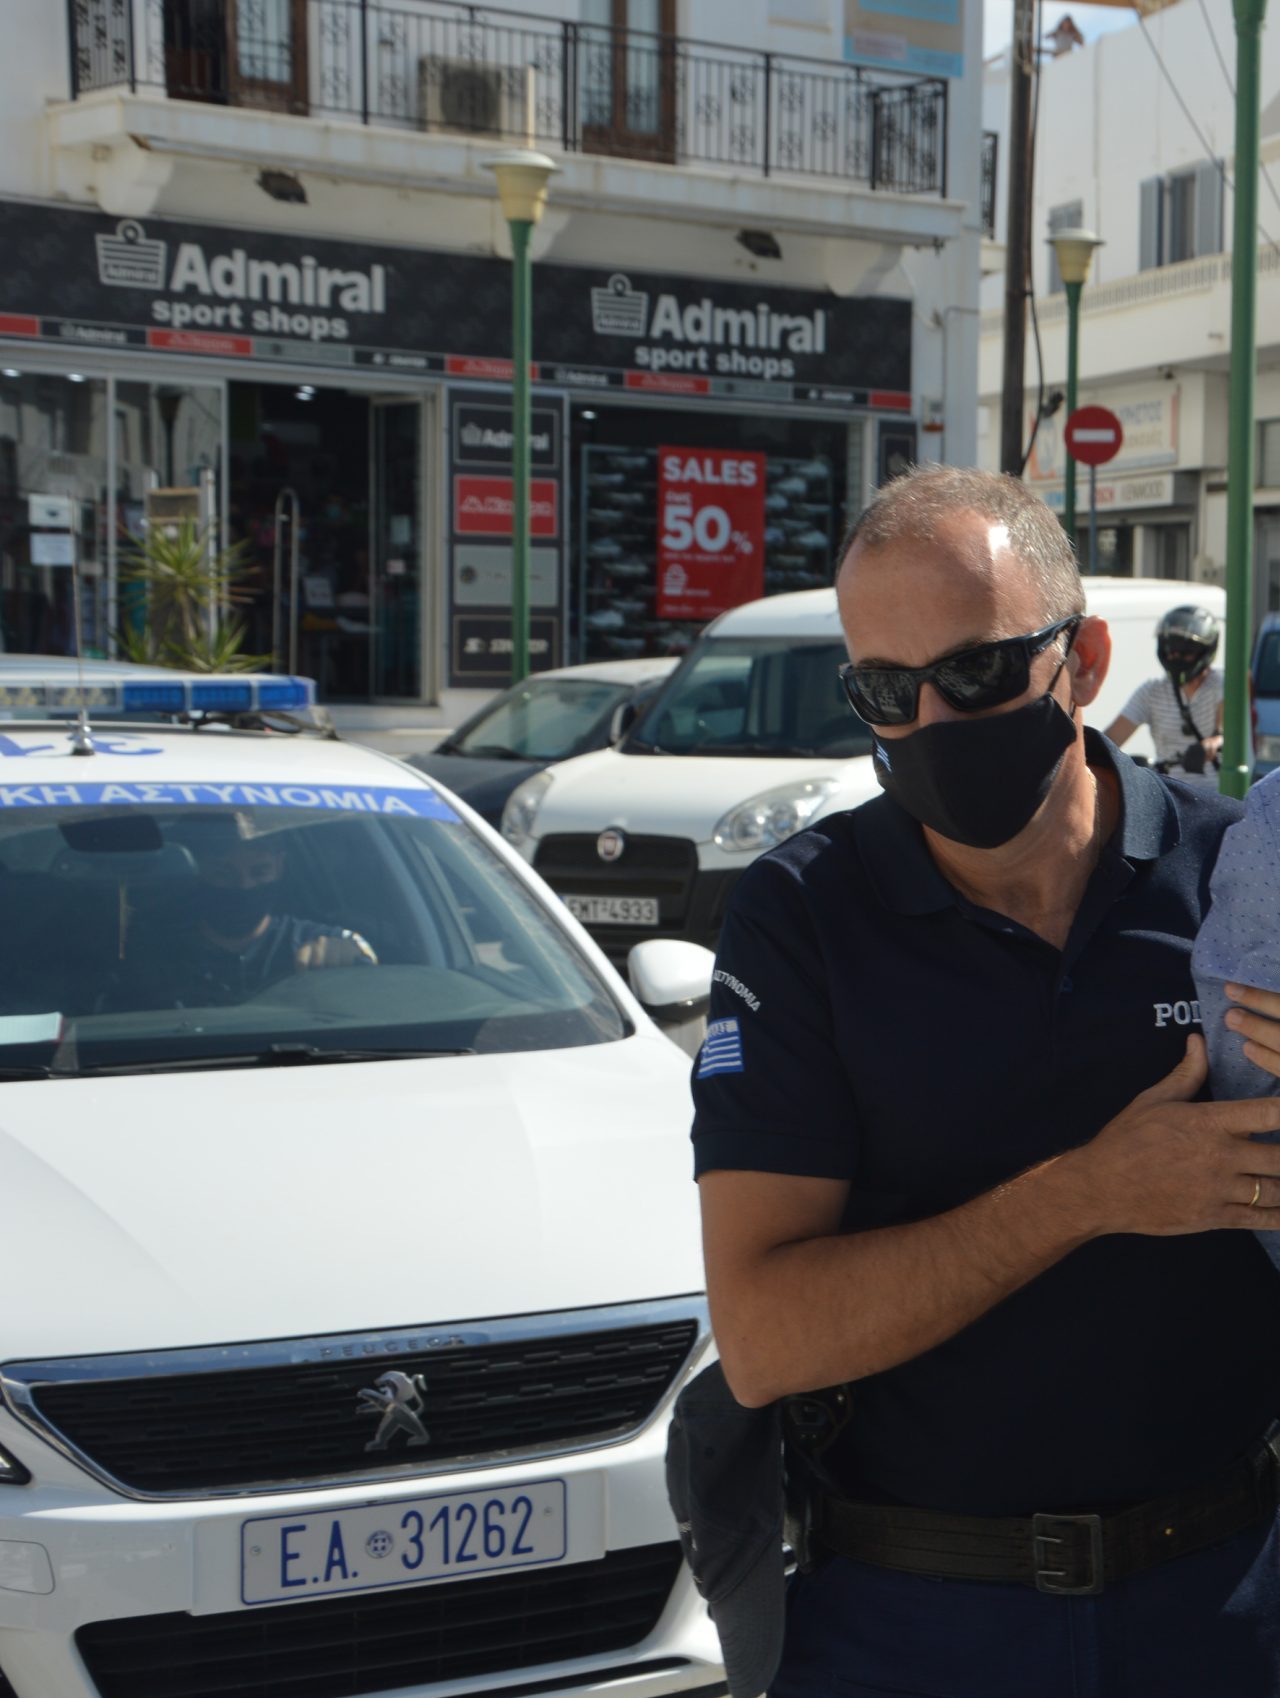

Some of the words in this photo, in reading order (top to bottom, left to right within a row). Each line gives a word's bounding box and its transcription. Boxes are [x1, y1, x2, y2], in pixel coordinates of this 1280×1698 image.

[170, 243, 386, 314] Admiral
[152, 299, 243, 329] sport
[252, 305, 348, 340] shops
[650, 294, 826, 353] Admiral
[634, 345, 709, 372] sport
[716, 348, 795, 380] shops
[663, 455, 758, 487] SALES
[661, 504, 754, 555] 50%
[98, 784, 420, 817] ΑΣΤΥΝΟΜΙΑ
[400, 1495, 535, 1570] 31262
